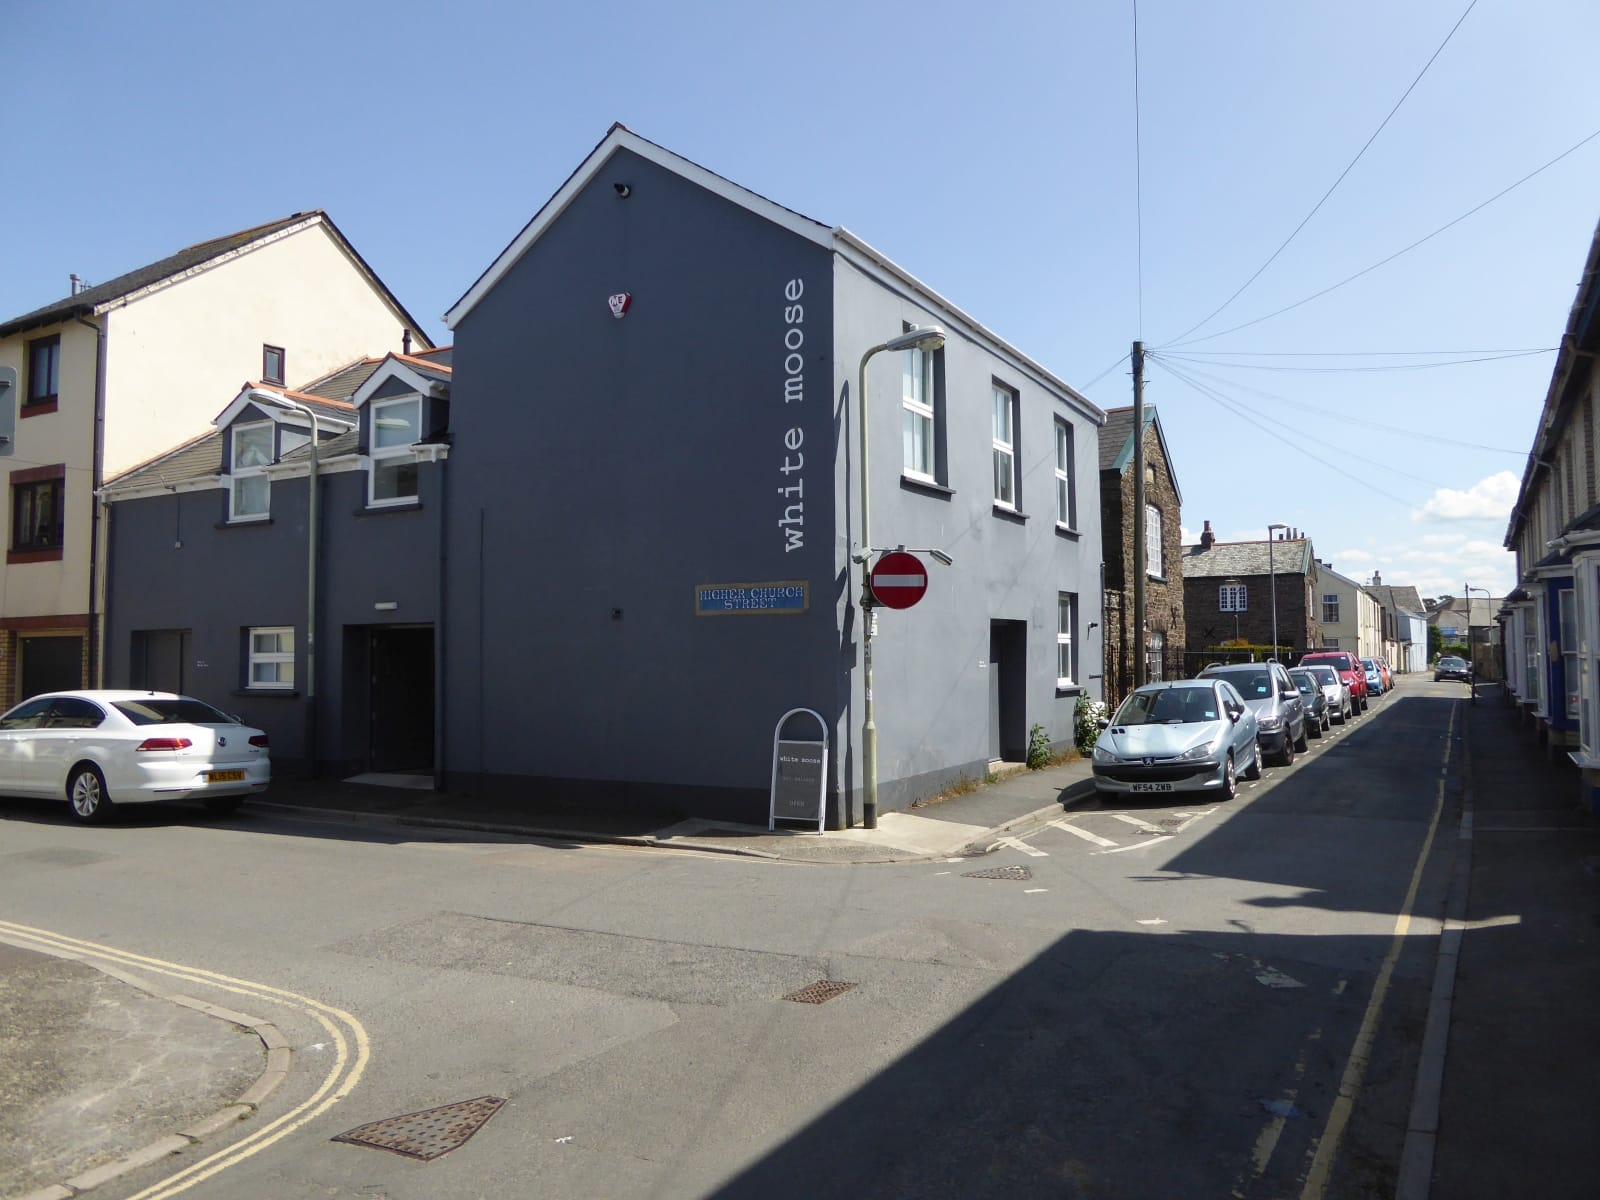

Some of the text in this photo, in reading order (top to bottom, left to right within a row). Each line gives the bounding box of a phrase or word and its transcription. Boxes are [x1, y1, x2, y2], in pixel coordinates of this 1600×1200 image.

[777, 278, 804, 552] white moose
[700, 586, 803, 600] HIGHER CHURCH
[724, 598, 776, 609] STREET
